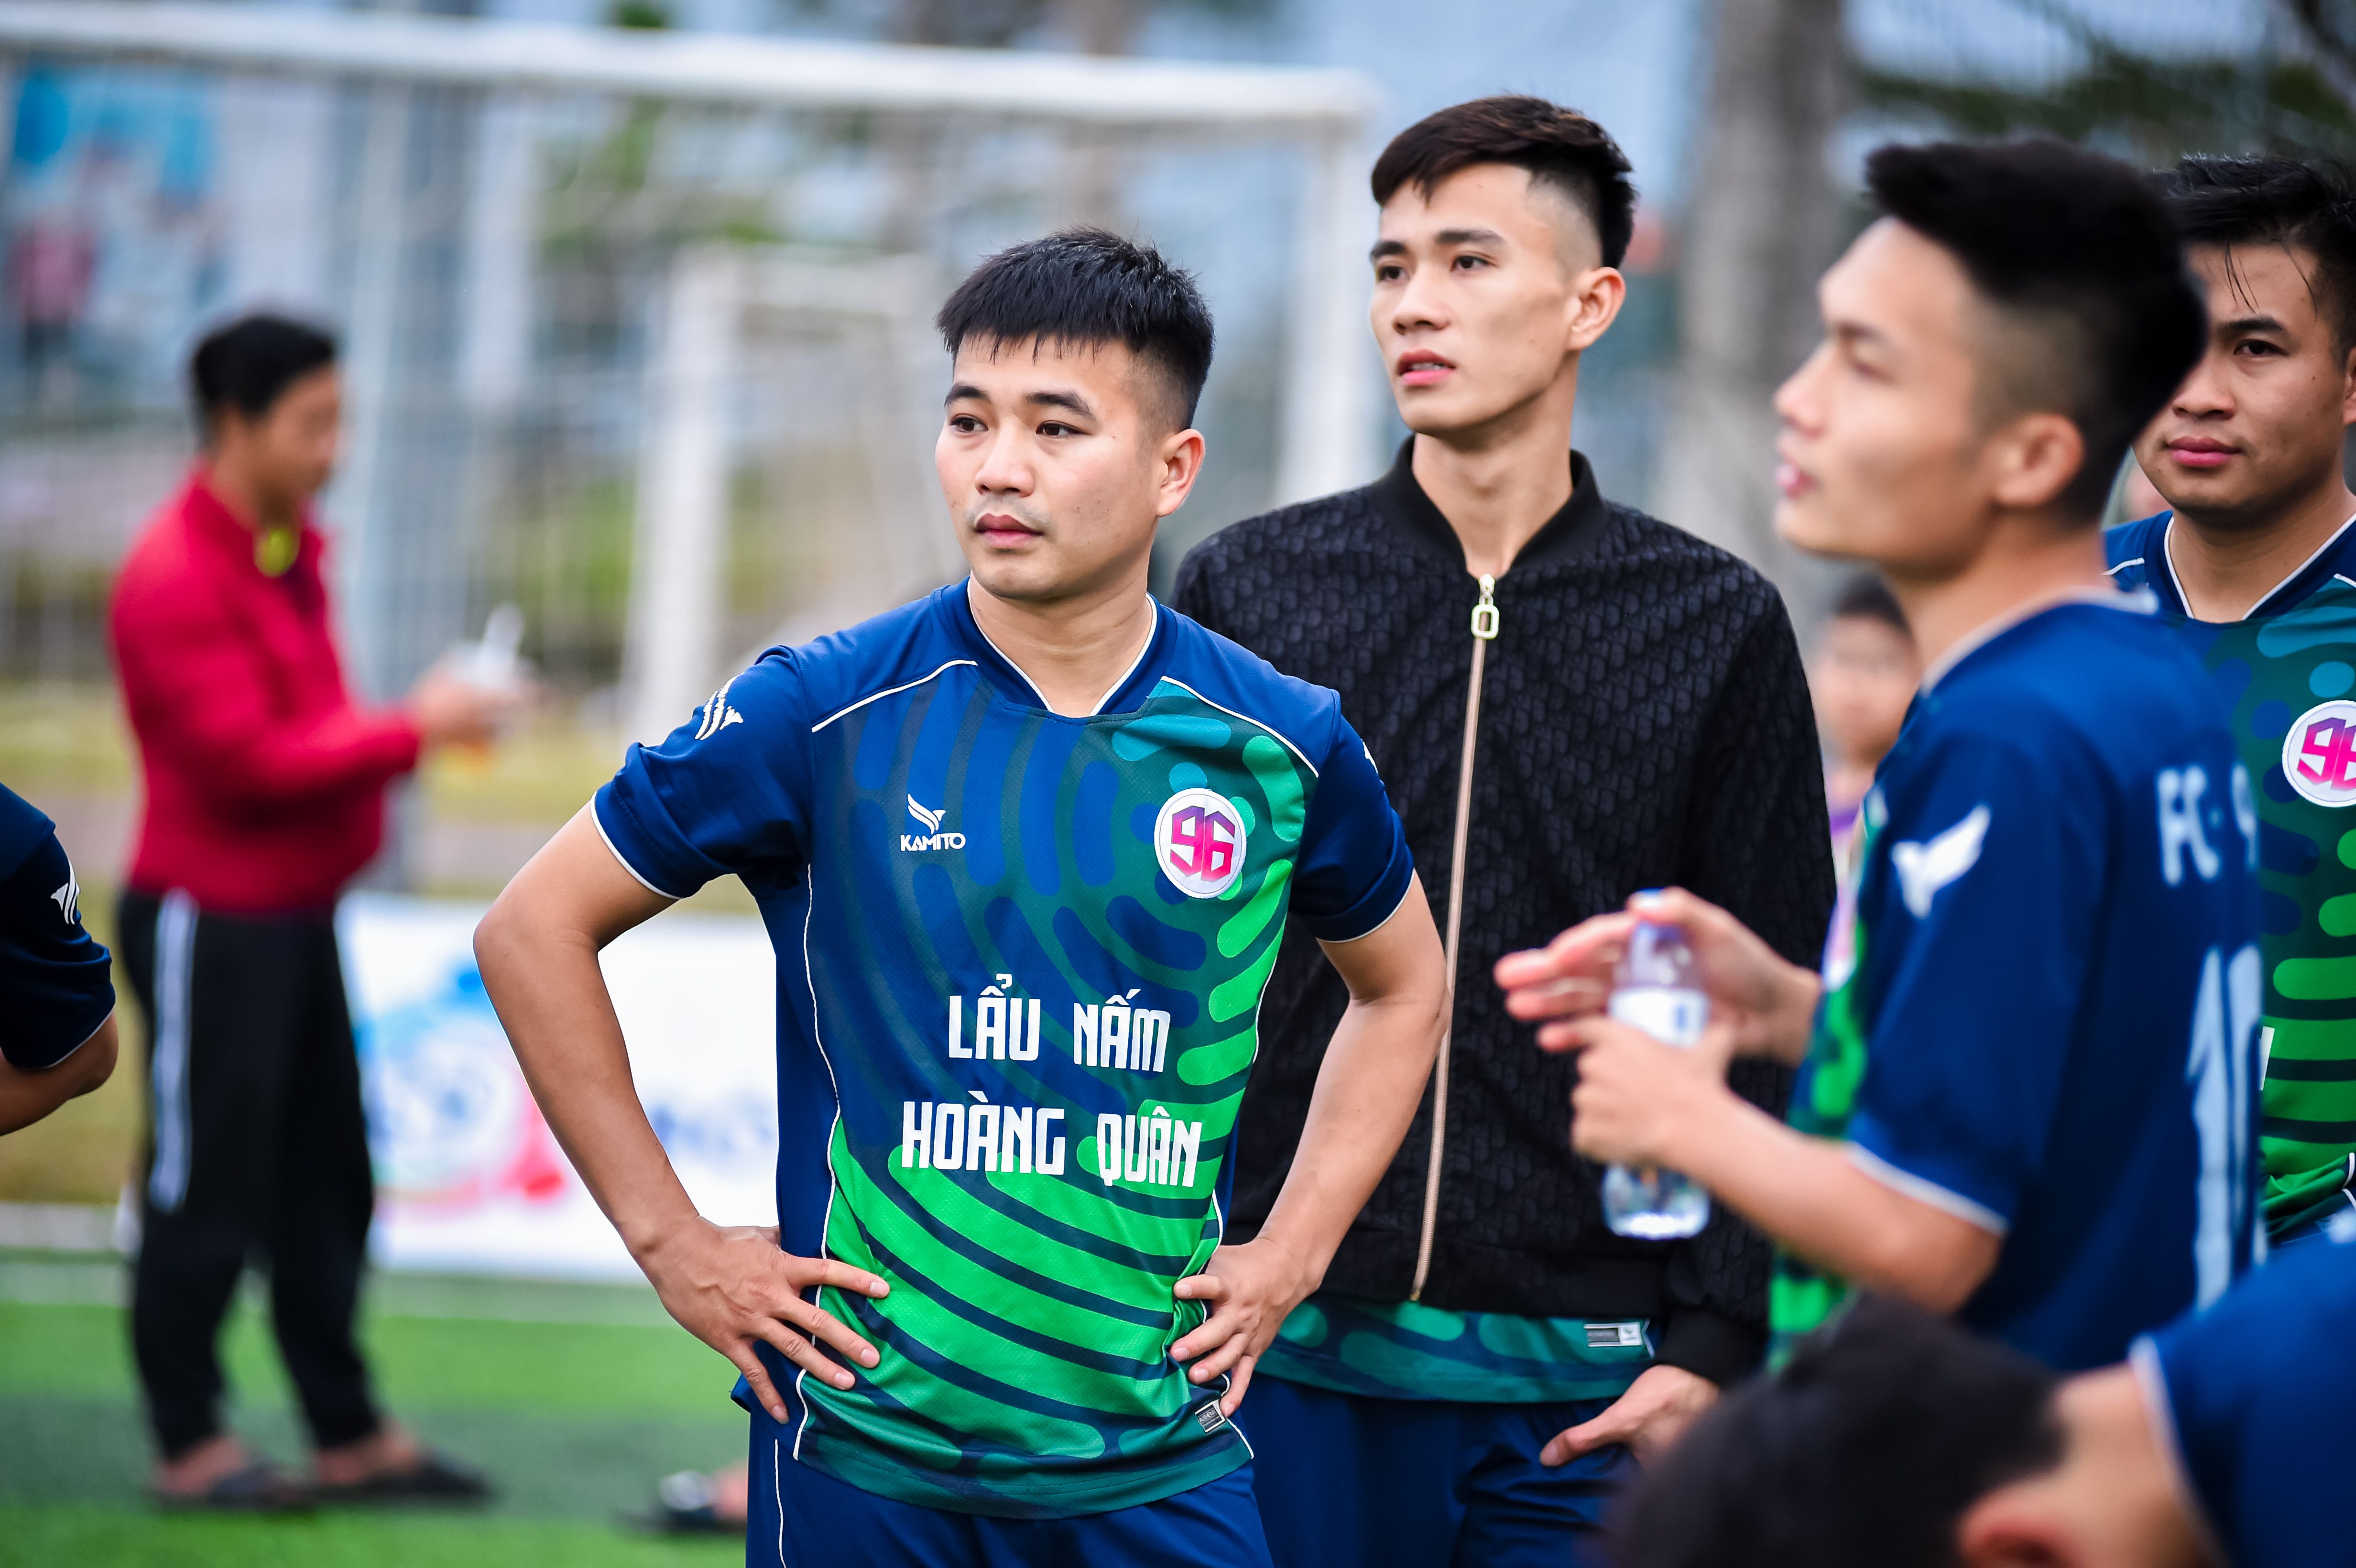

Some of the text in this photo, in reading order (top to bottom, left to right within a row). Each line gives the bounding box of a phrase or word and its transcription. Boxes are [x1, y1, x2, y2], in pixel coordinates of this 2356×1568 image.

[900, 832, 966, 851] KAMITO
[1170, 805, 1235, 882] 96
[949, 973, 1171, 1072] LẨU NẤM
[901, 1090, 1202, 1187] HOÀNG QUÂN
